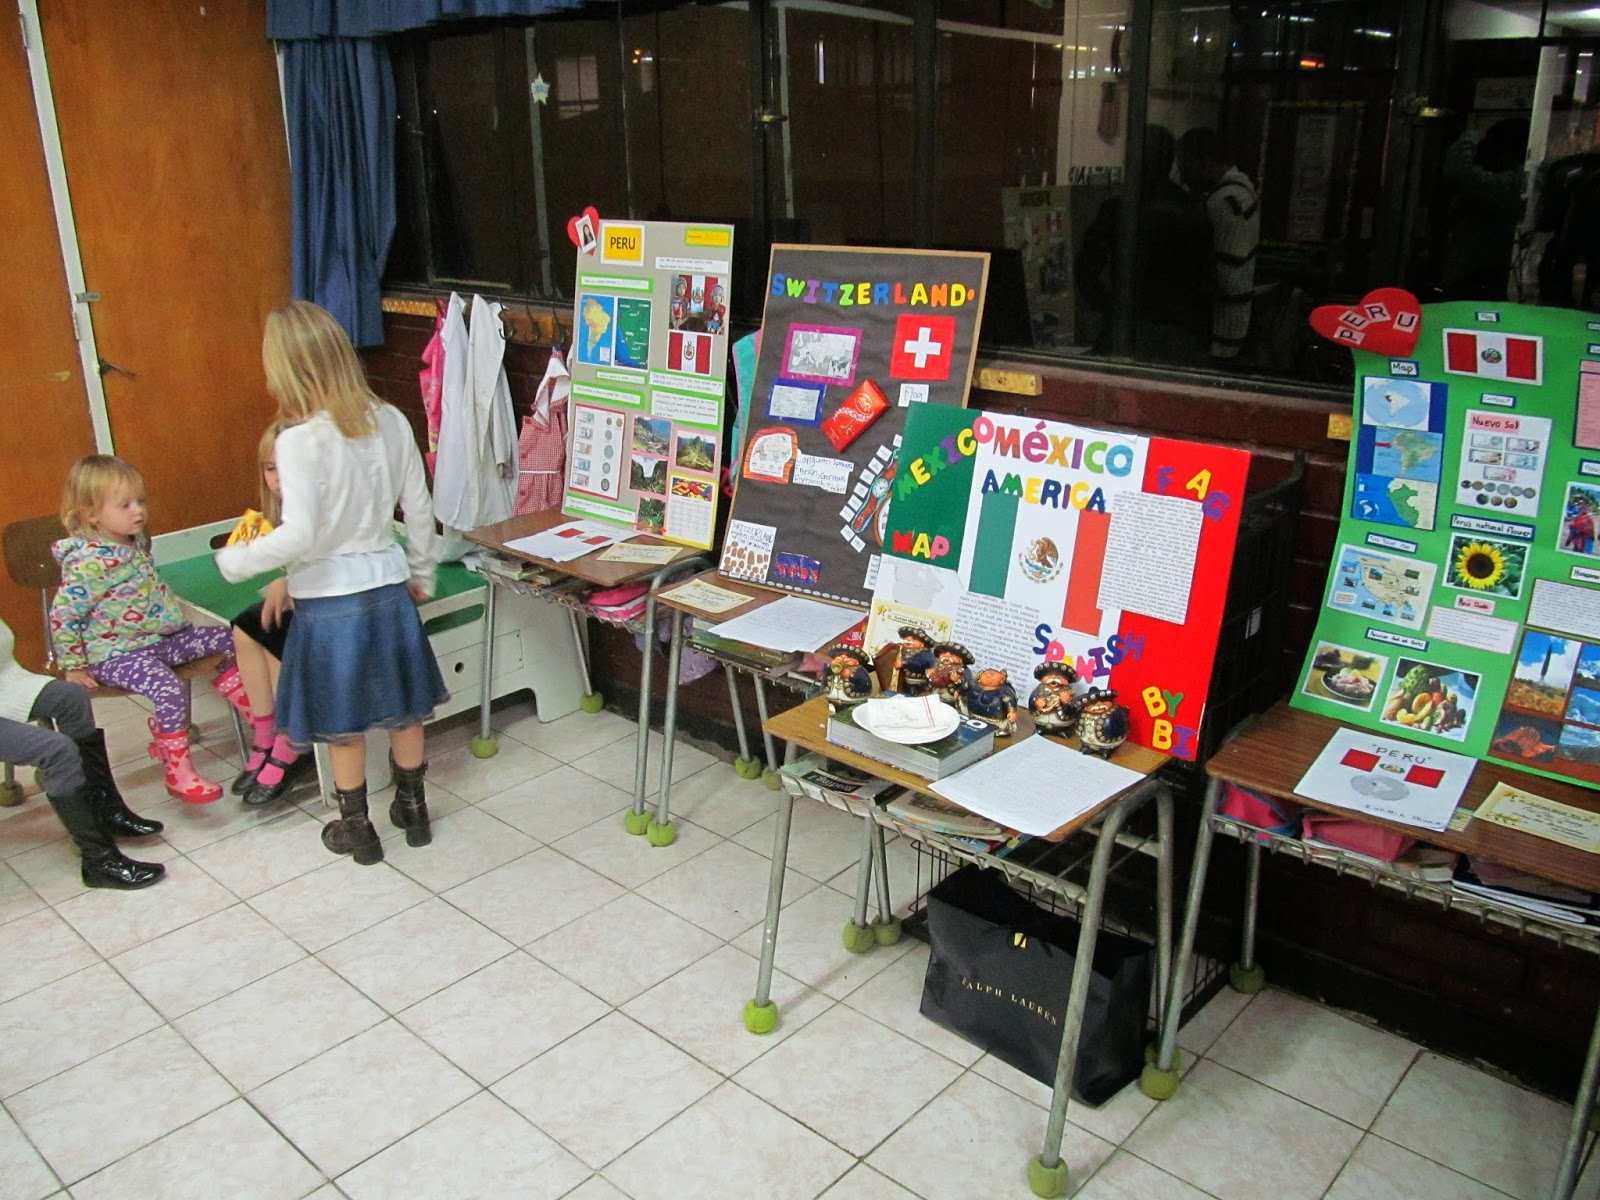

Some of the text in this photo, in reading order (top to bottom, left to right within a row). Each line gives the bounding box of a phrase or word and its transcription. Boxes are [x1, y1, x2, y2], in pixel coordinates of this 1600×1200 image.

[610, 237, 636, 250] PERU
[1339, 305, 1416, 341] PERU
[1393, 363, 1414, 374] Map
[1472, 417, 1520, 430] Nuevo Sol
[981, 469, 1107, 514] AMERICA
[1476, 523, 1504, 532] national
[1506, 526, 1531, 537] flower
[893, 531, 950, 559] MAP
[1142, 686, 1183, 717] BY
[1153, 719, 1197, 758] BI
[962, 977, 1057, 1026] RALPH LAUREN
